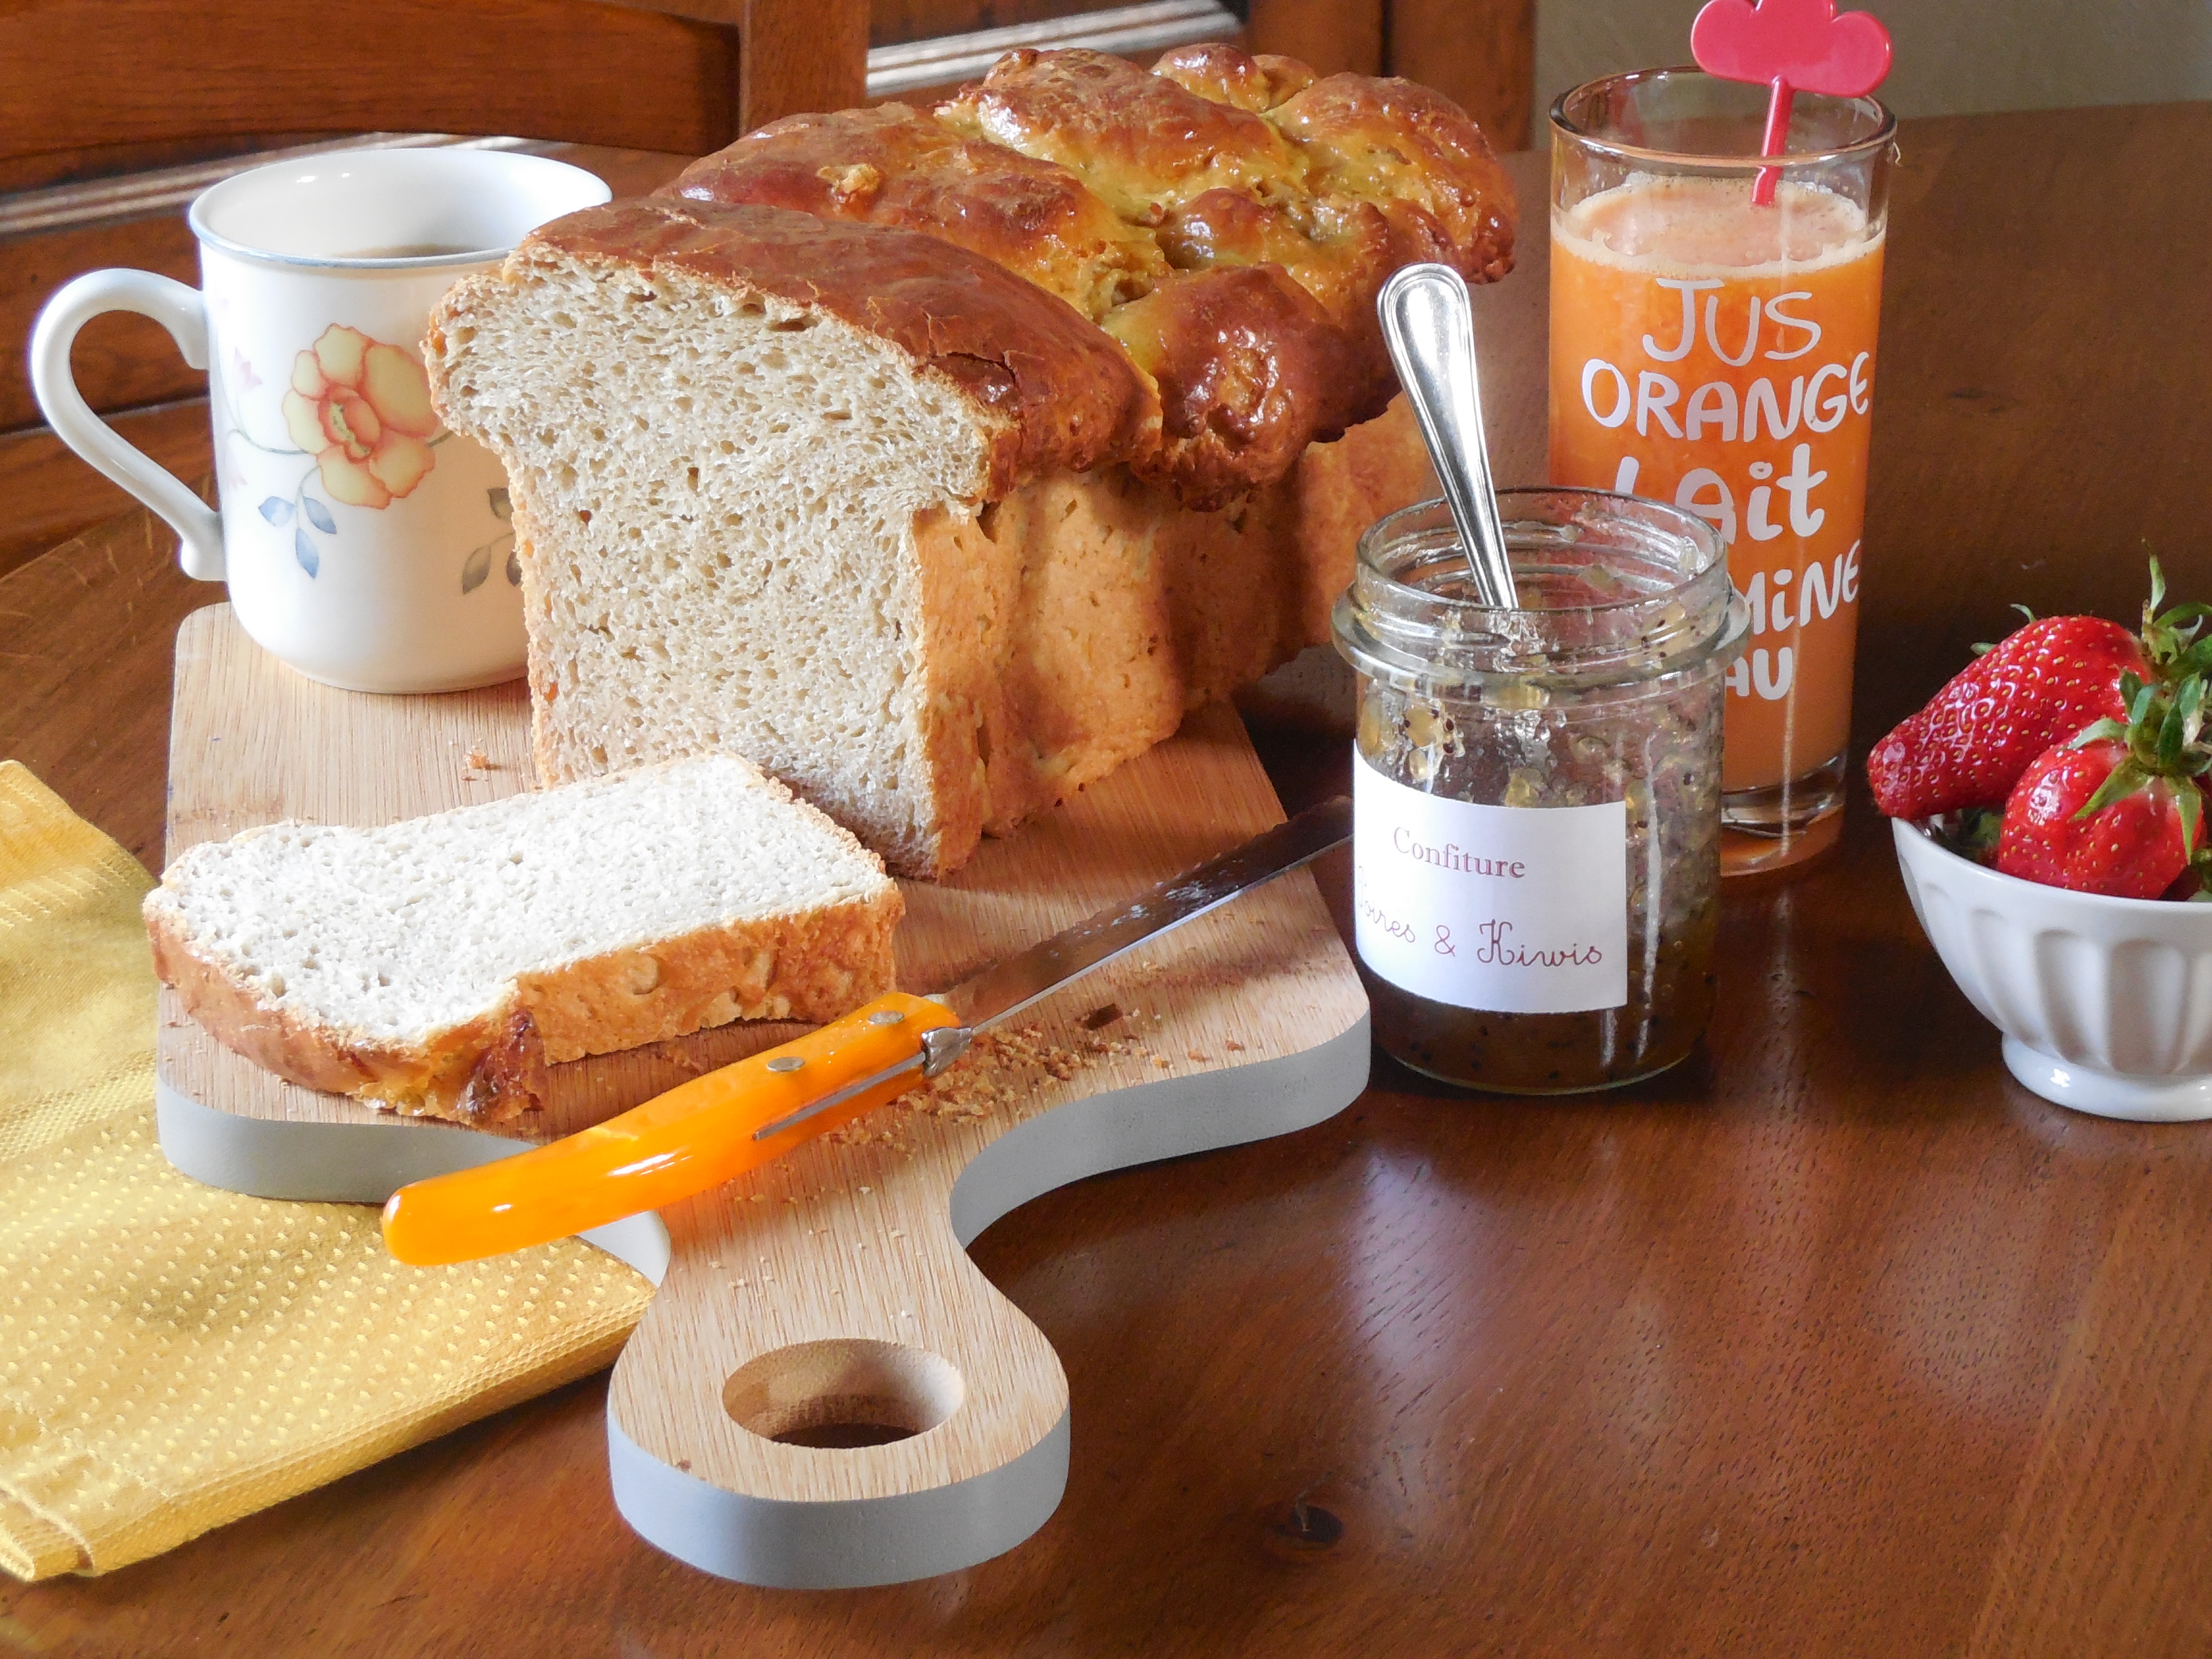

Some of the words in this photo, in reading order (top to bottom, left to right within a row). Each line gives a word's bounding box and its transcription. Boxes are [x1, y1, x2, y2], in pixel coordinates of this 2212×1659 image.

[1642, 278, 1822, 367] JUS
[1580, 351, 1870, 443] ORANGE
[1393, 826, 1526, 879] Confiture
[1434, 924, 1456, 958] &
[1476, 918, 1603, 967] Kiwis
